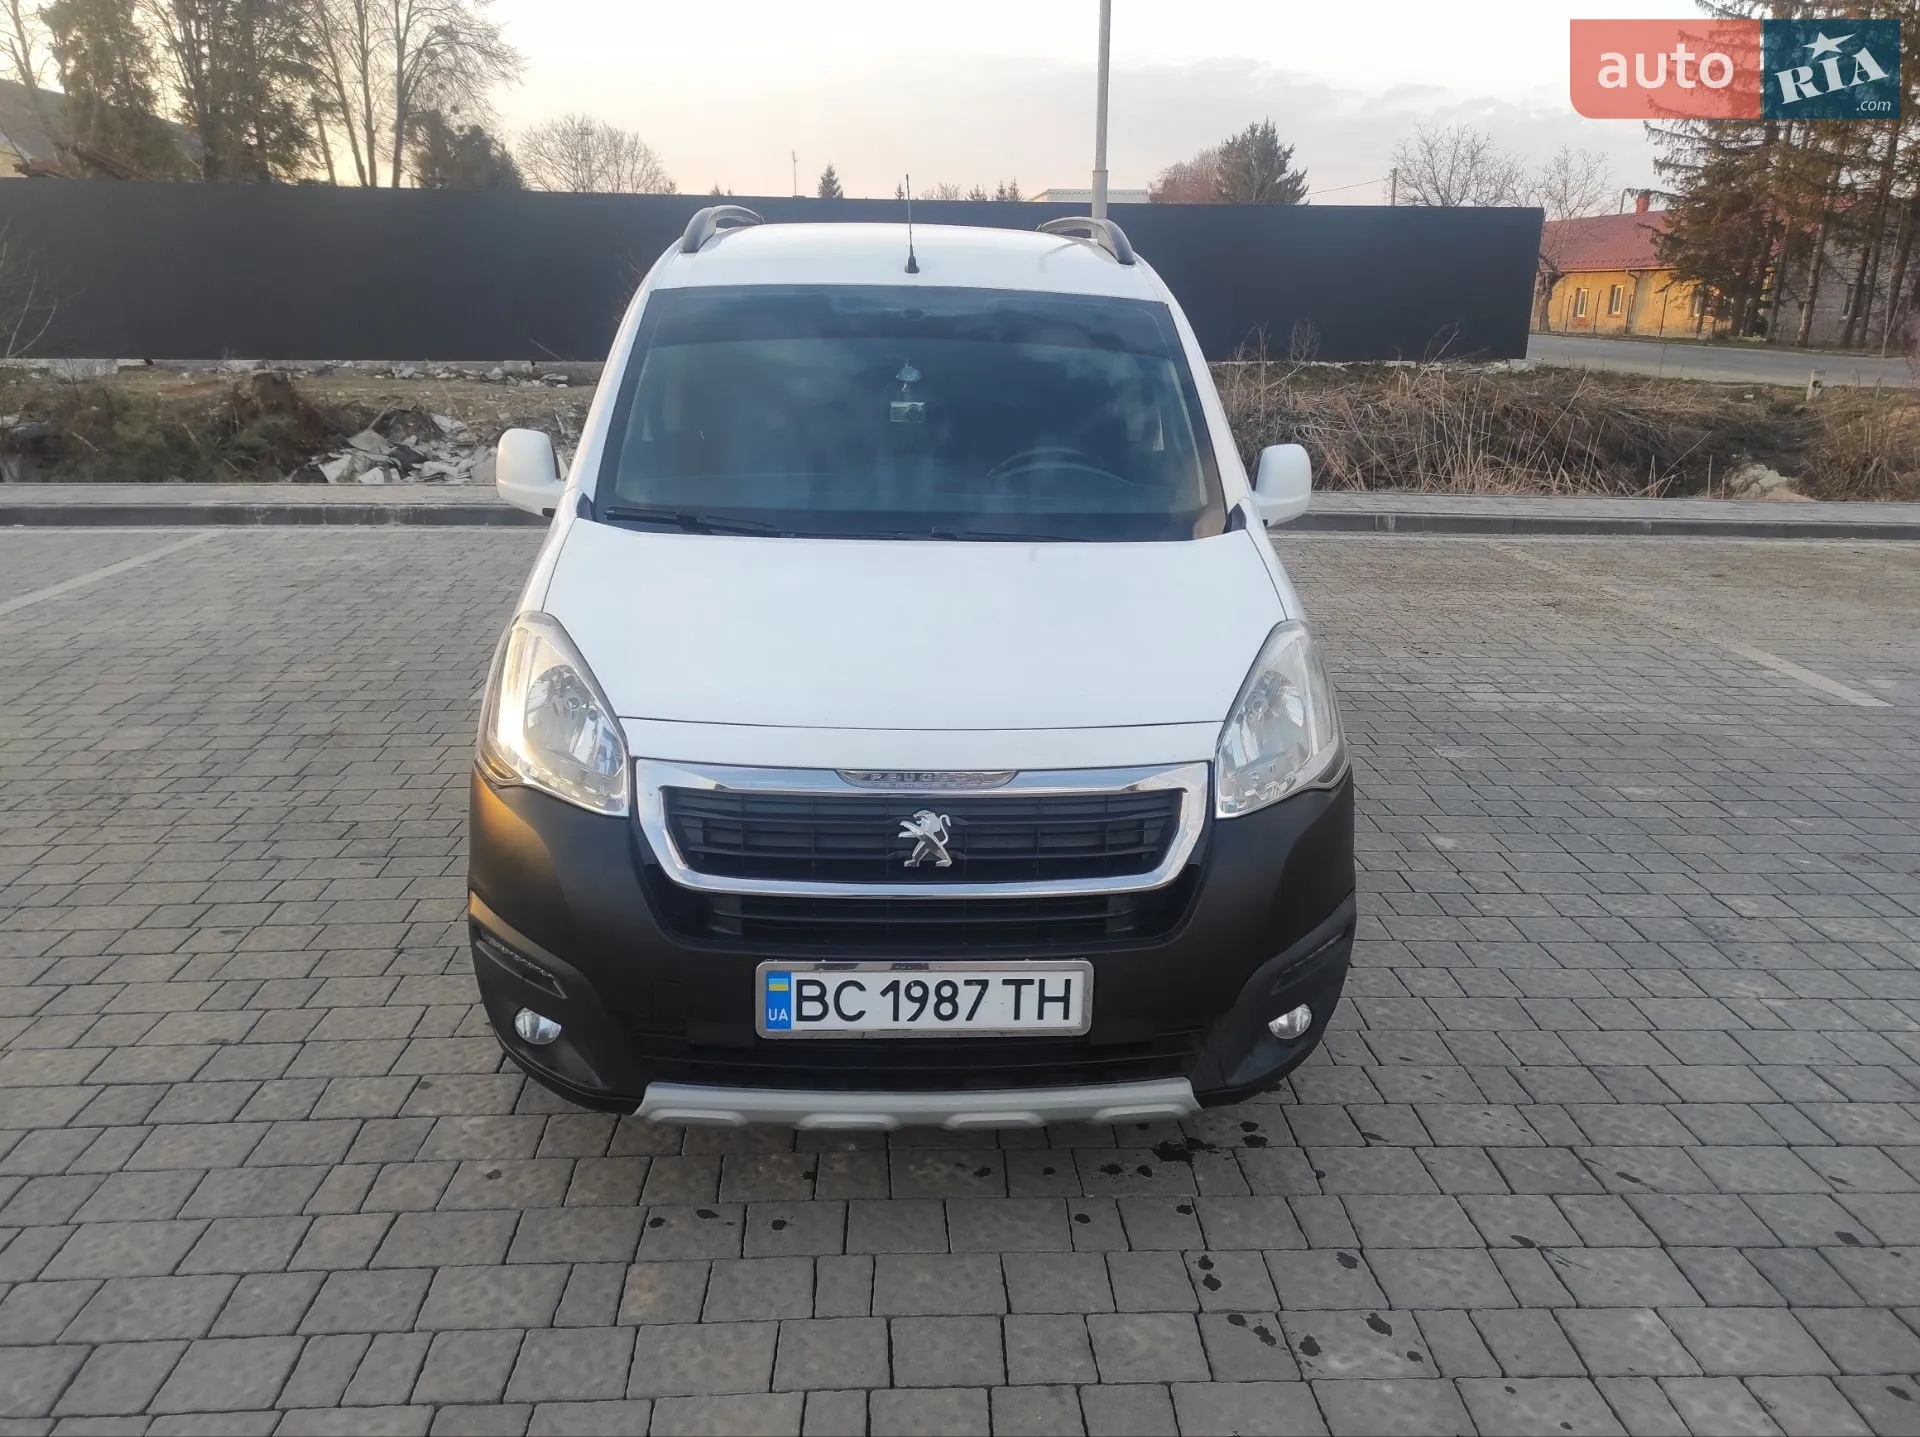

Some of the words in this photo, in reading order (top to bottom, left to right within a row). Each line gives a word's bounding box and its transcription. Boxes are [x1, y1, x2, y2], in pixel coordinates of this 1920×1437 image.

[796, 979, 867, 1022] BC
[879, 978, 989, 1022] 1987
[1001, 978, 1072, 1021] TH
[768, 1009, 788, 1021] UA
